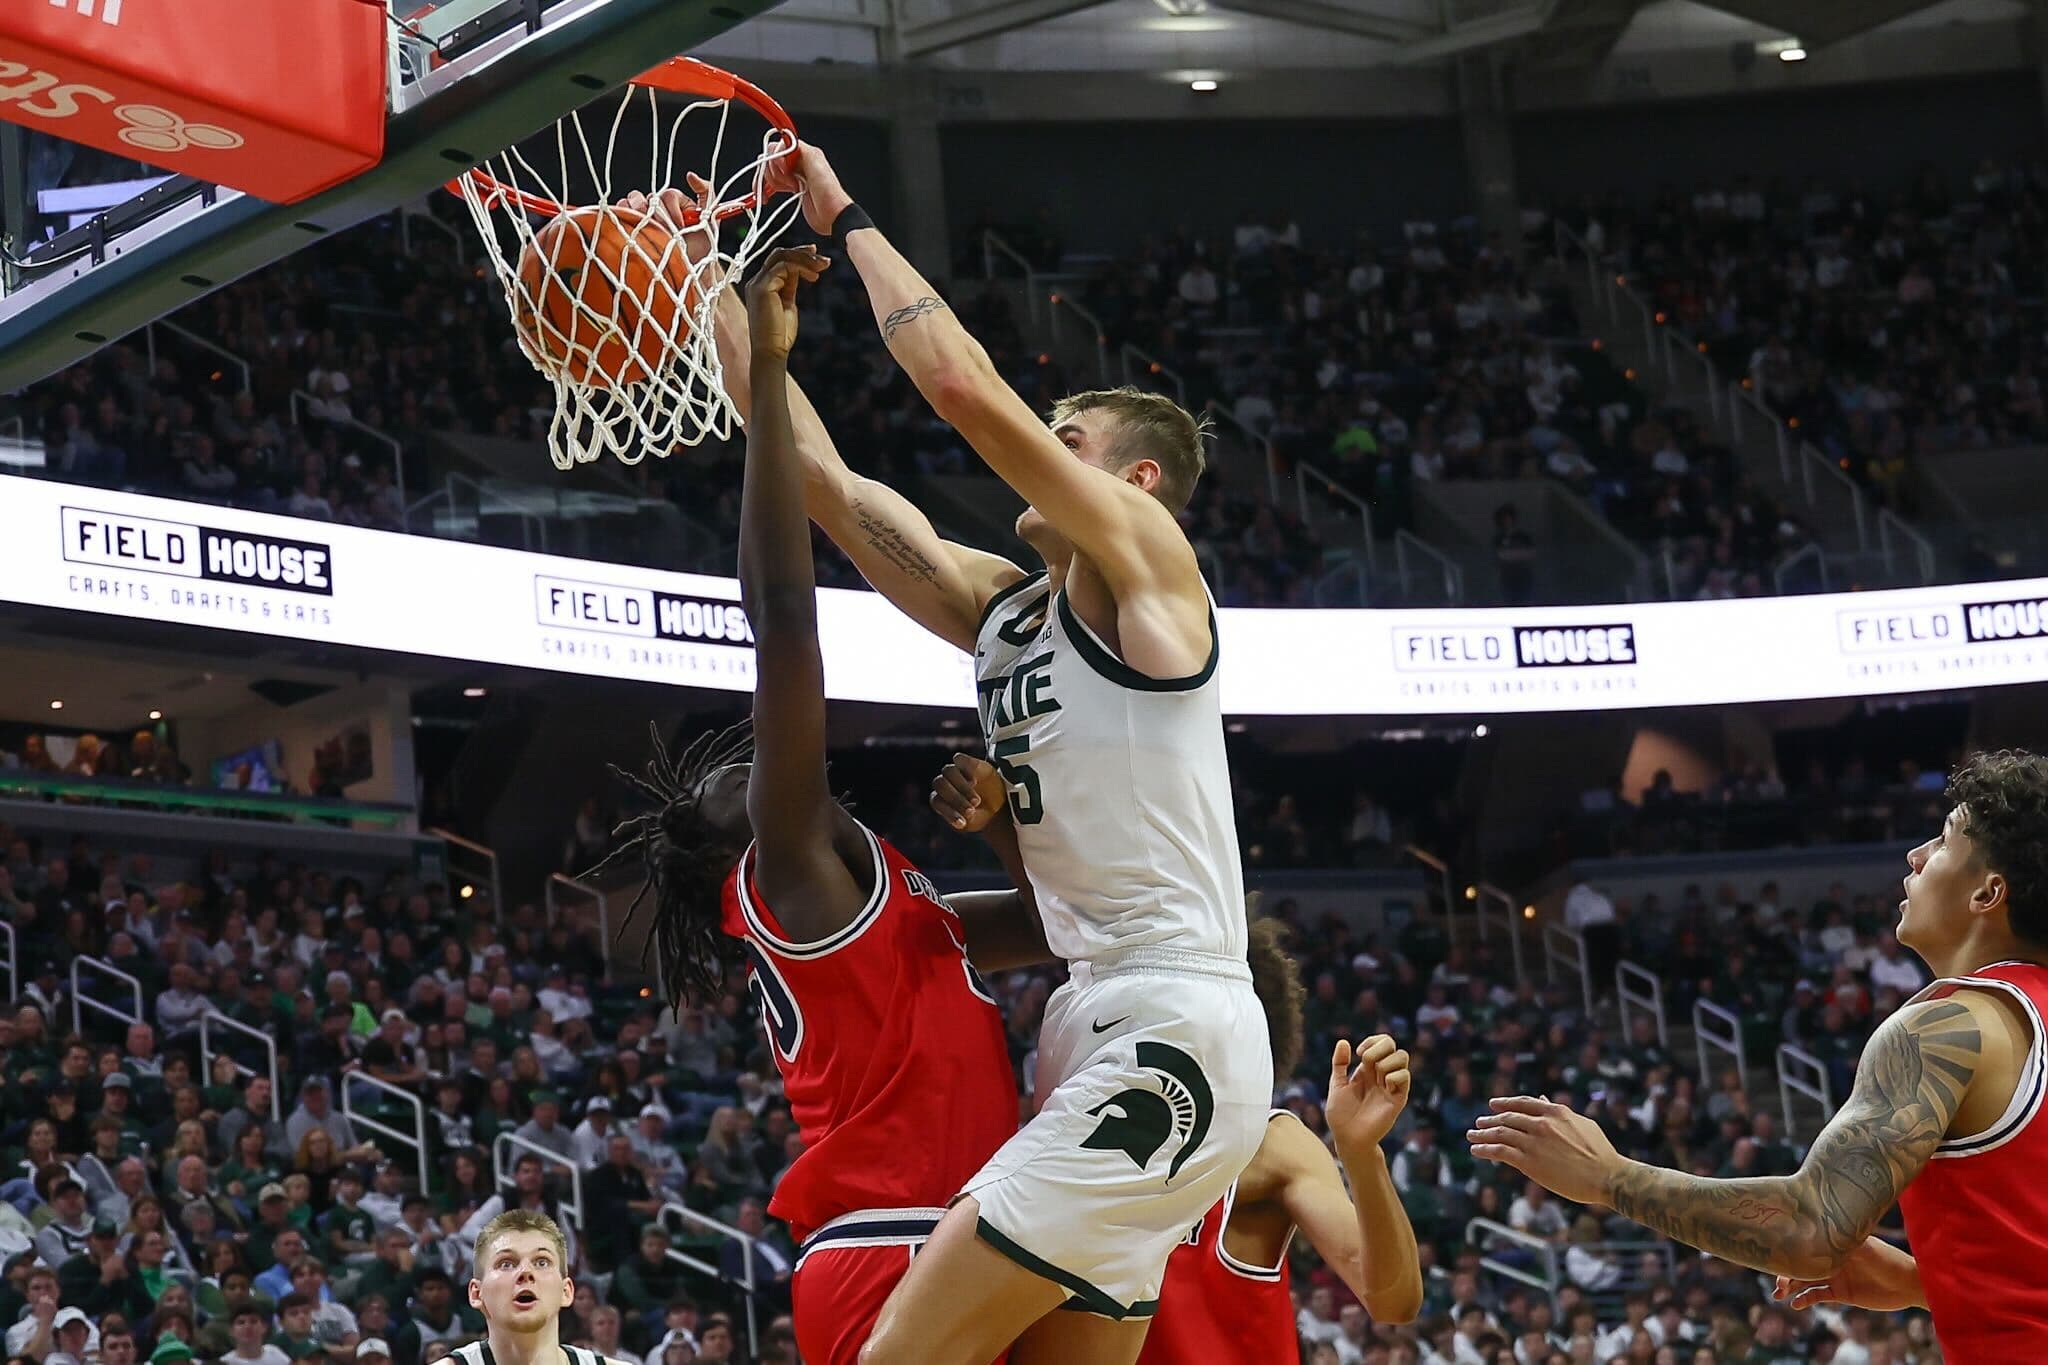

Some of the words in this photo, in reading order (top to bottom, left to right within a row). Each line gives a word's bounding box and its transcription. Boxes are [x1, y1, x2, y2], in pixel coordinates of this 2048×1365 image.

[79, 520, 185, 564] FIELD
[207, 535, 329, 588] HOUSE
[171, 588, 249, 614] DRAFTS
[262, 602, 271, 617] &
[284, 604, 331, 625] EATS
[551, 588, 641, 625] FIELD
[659, 598, 755, 643] HOUS
[1855, 614, 1950, 643] FIELD
[1968, 600, 2048, 640] HOU
[1408, 636, 1501, 661] FIELD
[1519, 627, 1634, 664] HOUSE
